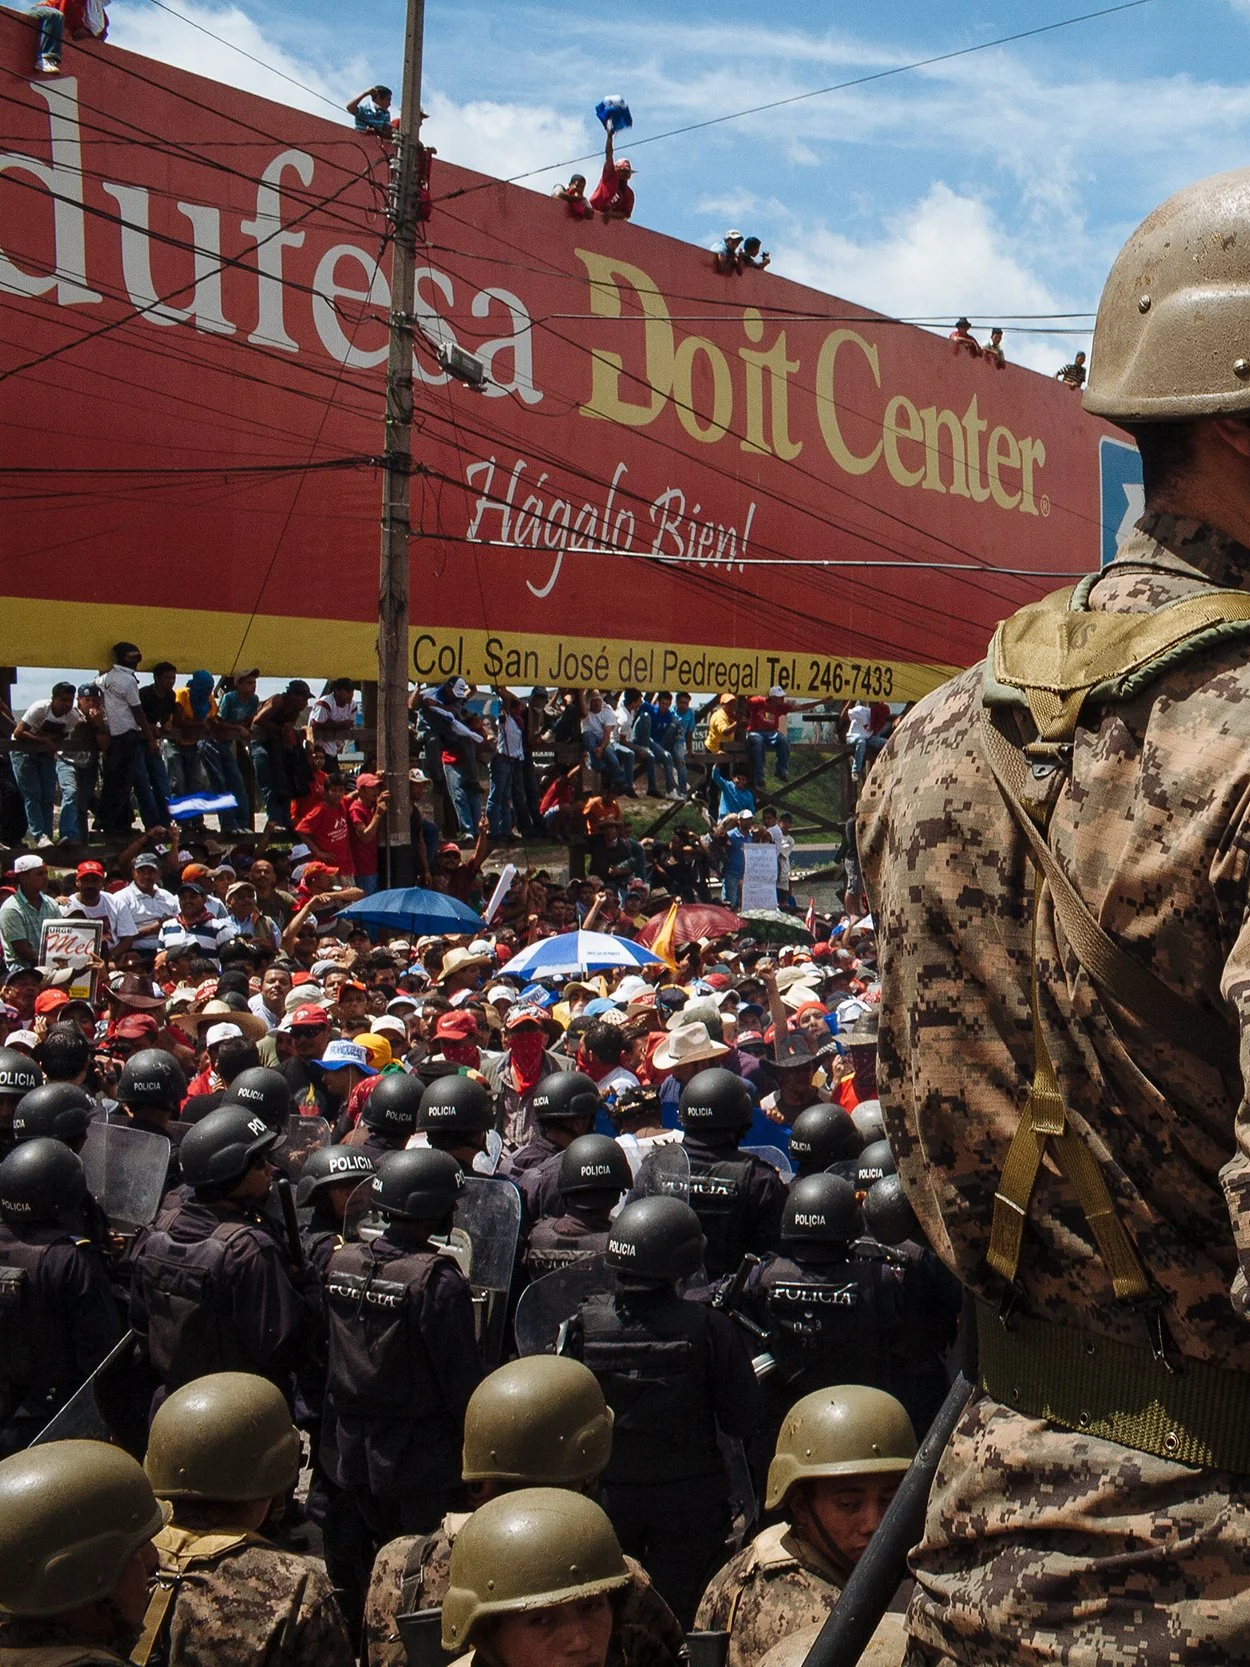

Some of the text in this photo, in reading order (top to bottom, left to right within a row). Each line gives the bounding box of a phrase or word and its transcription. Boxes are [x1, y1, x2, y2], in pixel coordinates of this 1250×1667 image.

[466, 455, 756, 598] Hágalo Bien!
[413, 634, 894, 697] Col. San José del Pedregal Tel. 246-7433
[46, 933, 96, 956] Mel
[133, 1081, 161, 1092] POLICIA
[237, 1087, 265, 1102] POLICIA
[386, 1109, 413, 1122] POLICIA
[428, 1105, 457, 1117] POLICIA
[686, 1106, 714, 1117] POLICIA
[790, 1139, 812, 1152] POLICIA
[328, 1155, 375, 1174] POLICIA
[580, 1165, 612, 1177] POLICIA
[858, 1168, 884, 1180] POLICIA
[794, 1213, 826, 1227] POLICIA
[608, 1239, 637, 1258] POLICIA
